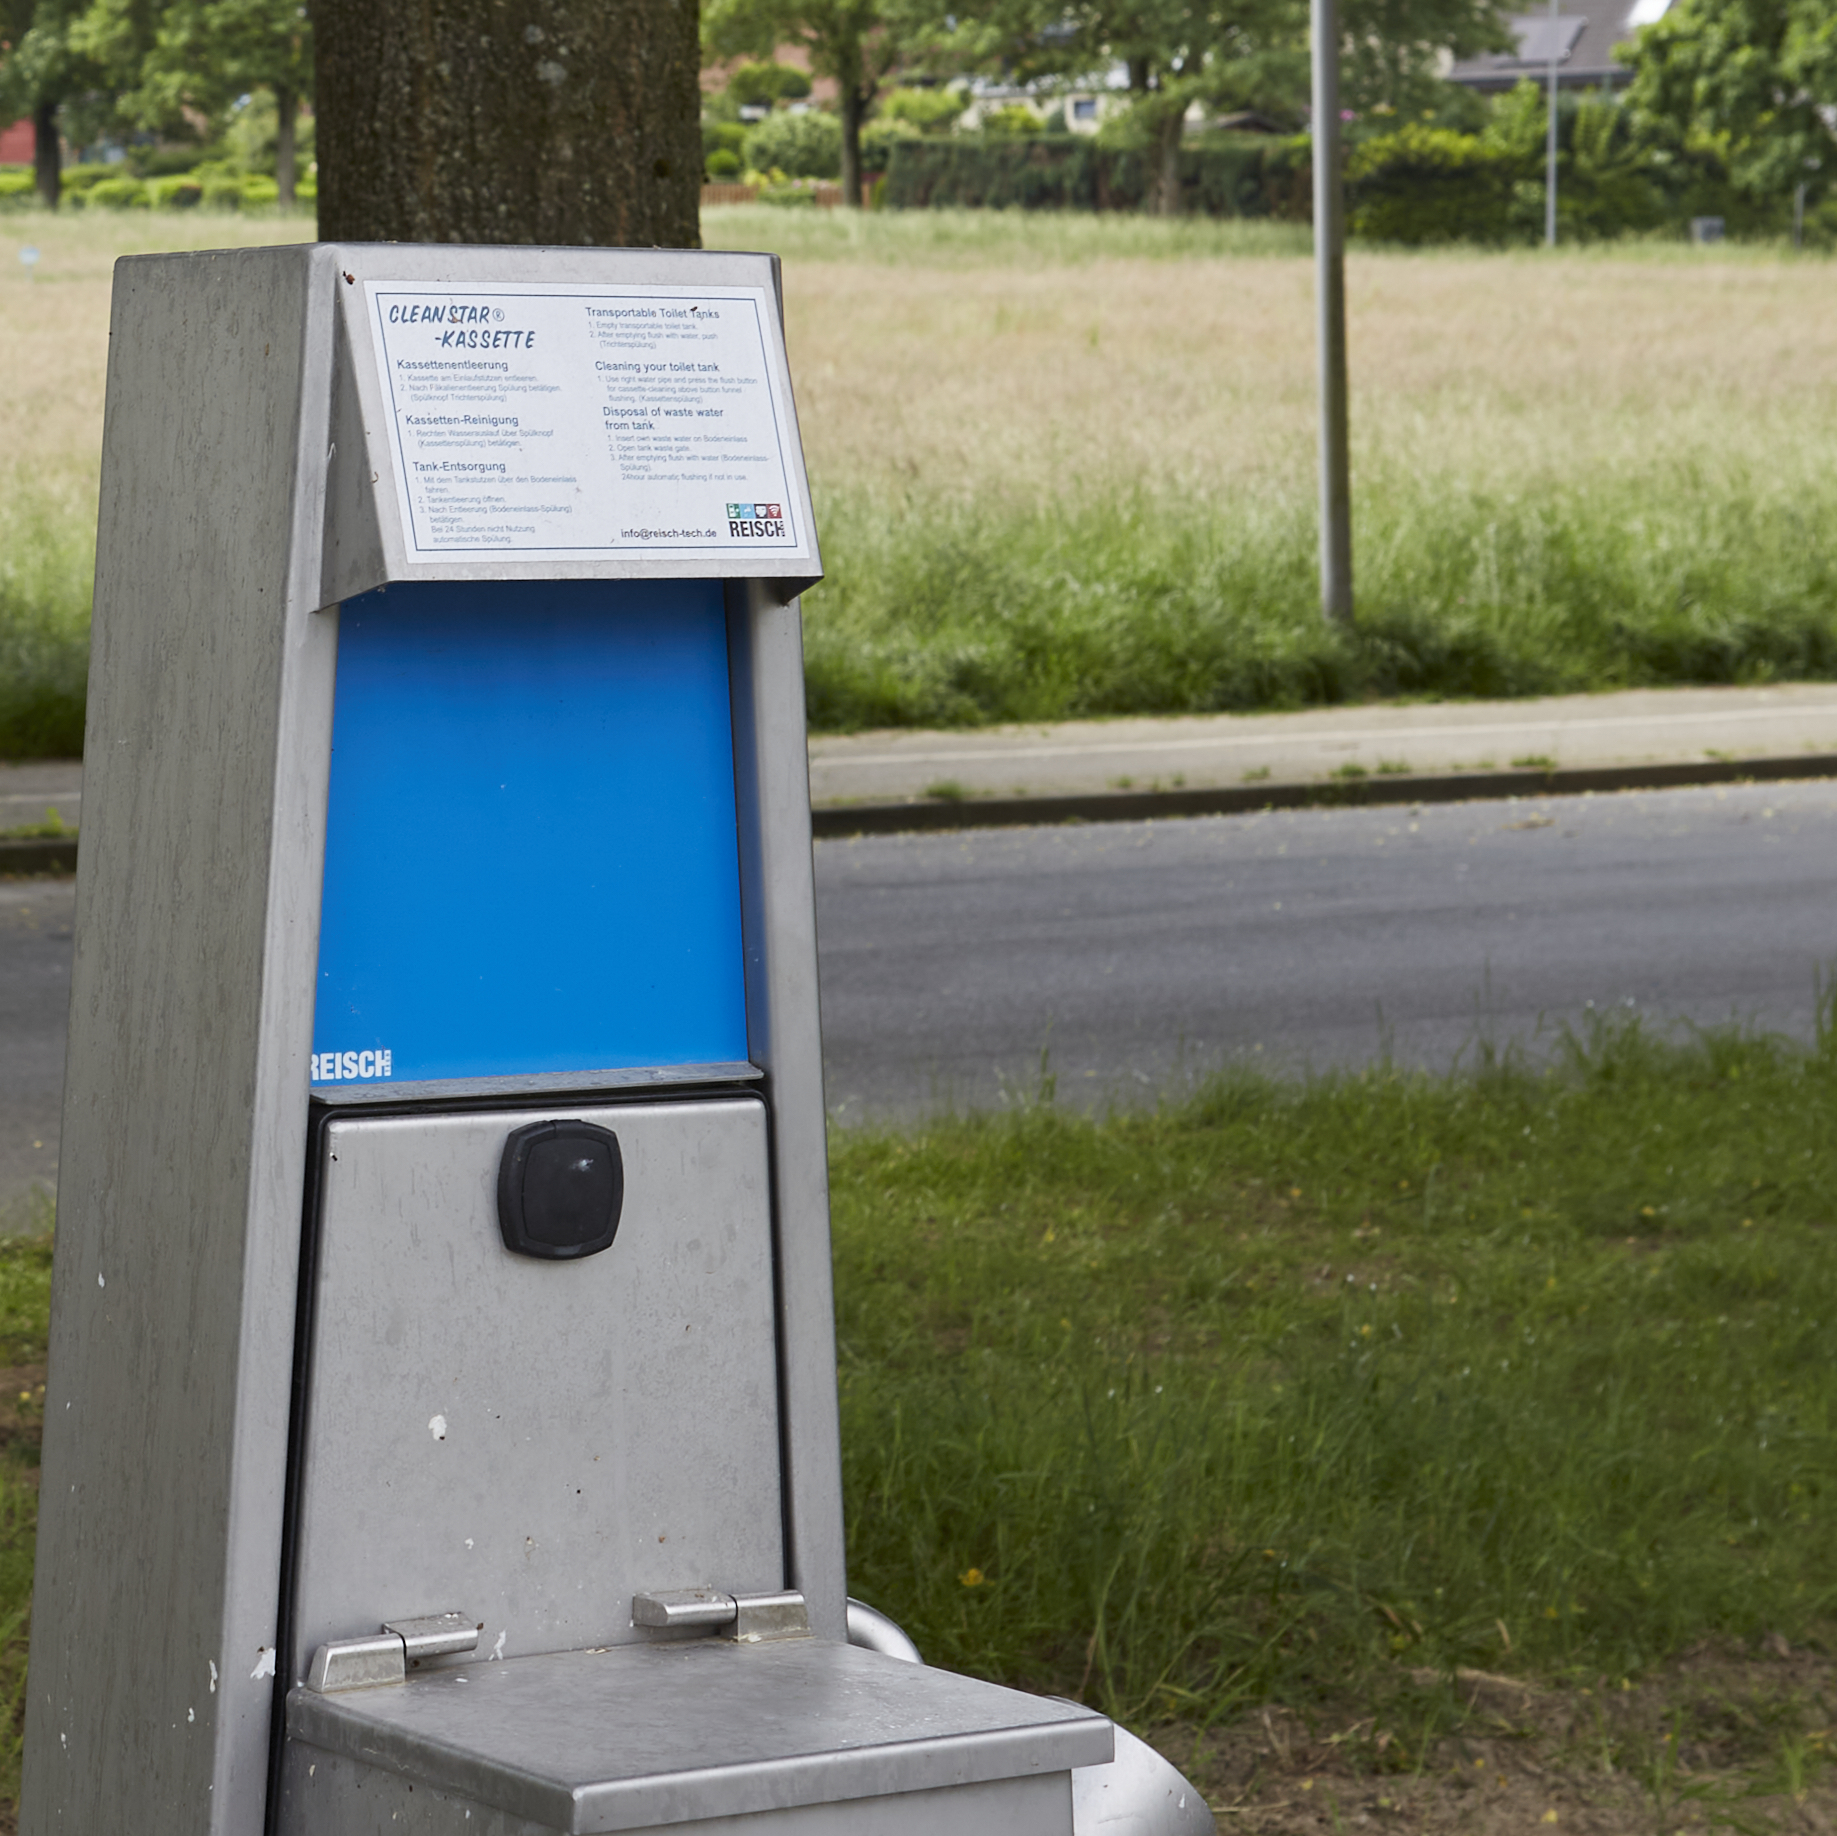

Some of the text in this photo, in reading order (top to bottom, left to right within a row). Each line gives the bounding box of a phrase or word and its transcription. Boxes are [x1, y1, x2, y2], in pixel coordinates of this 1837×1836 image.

[585, 307, 720, 319] Transportable Toilet Tanks
[435, 330, 535, 349] -KASSETTE
[397, 360, 508, 372] Kassettenentleerung
[595, 361, 720, 373] Cleaning your toilet tank
[603, 406, 724, 418] Disposal of waste water
[405, 415, 519, 427] Kassetten-Reinigung
[605, 420, 655, 430] from tank
[412, 461, 506, 474] Tank-Entsorgung
[621, 528, 717, 540] info@reisch-tech.de
[728, 520, 785, 537] REISCH
